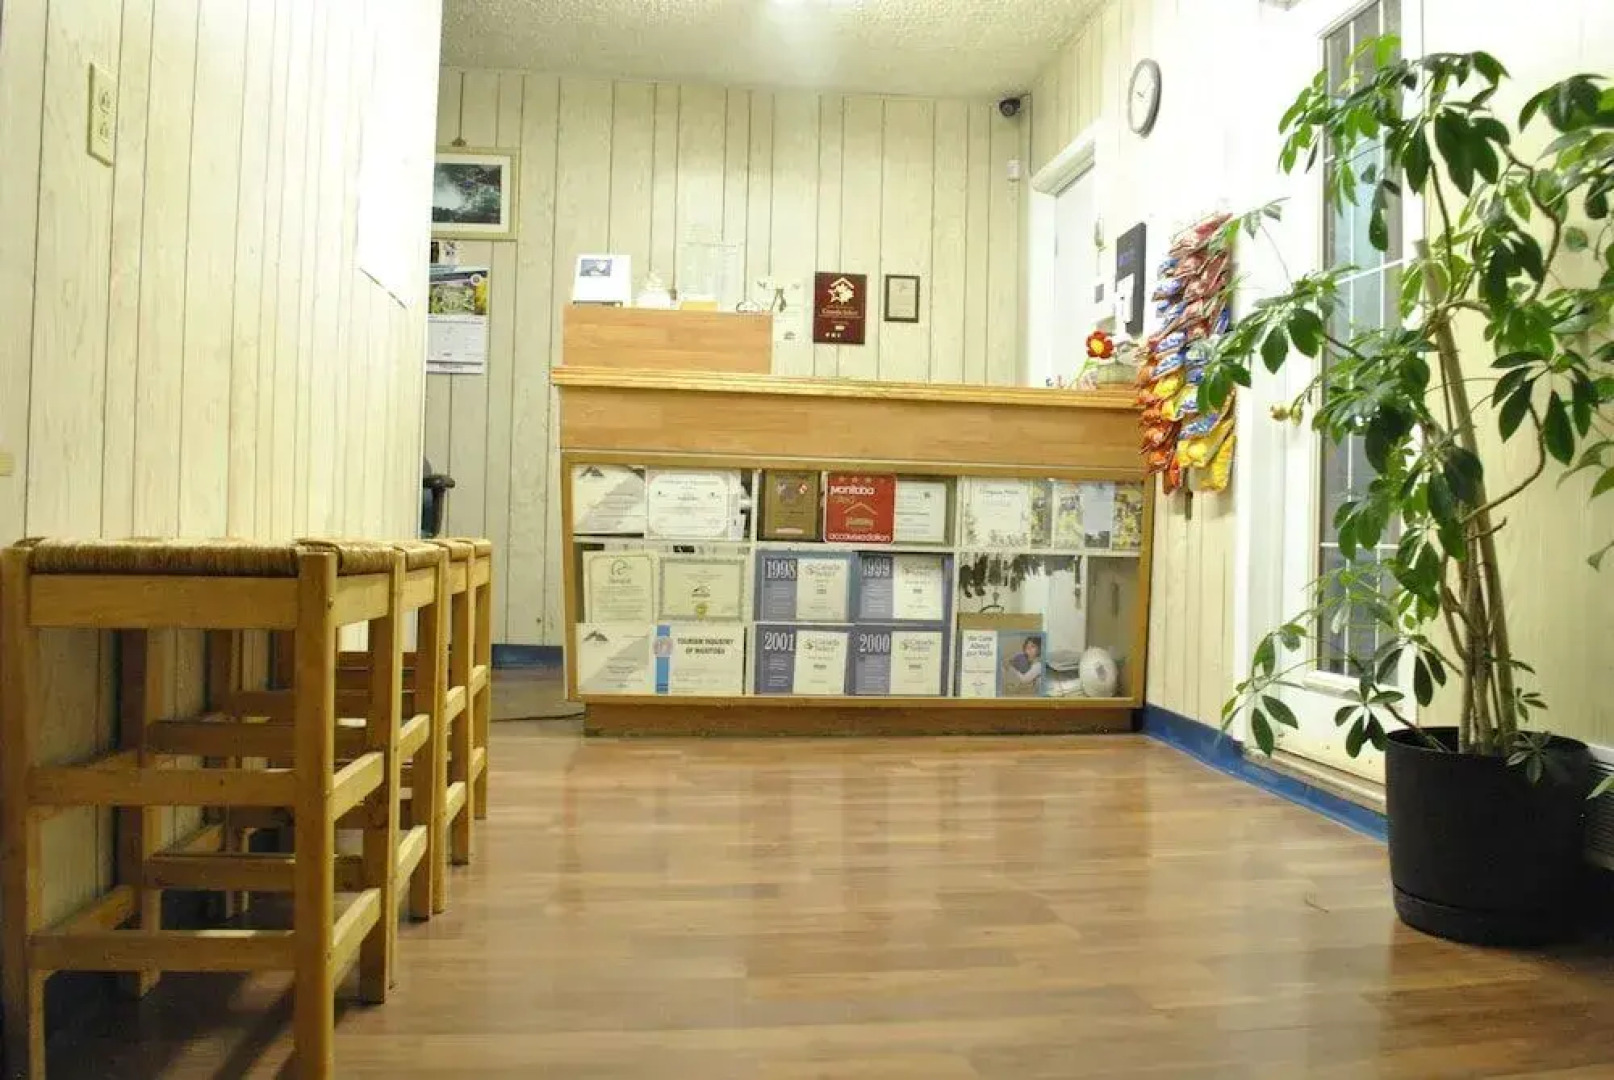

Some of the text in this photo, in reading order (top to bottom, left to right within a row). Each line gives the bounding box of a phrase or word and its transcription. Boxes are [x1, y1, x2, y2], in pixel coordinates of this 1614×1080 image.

[767, 559, 797, 579] 1998
[764, 632, 794, 652] 2001
[859, 633, 890, 653] 2000
